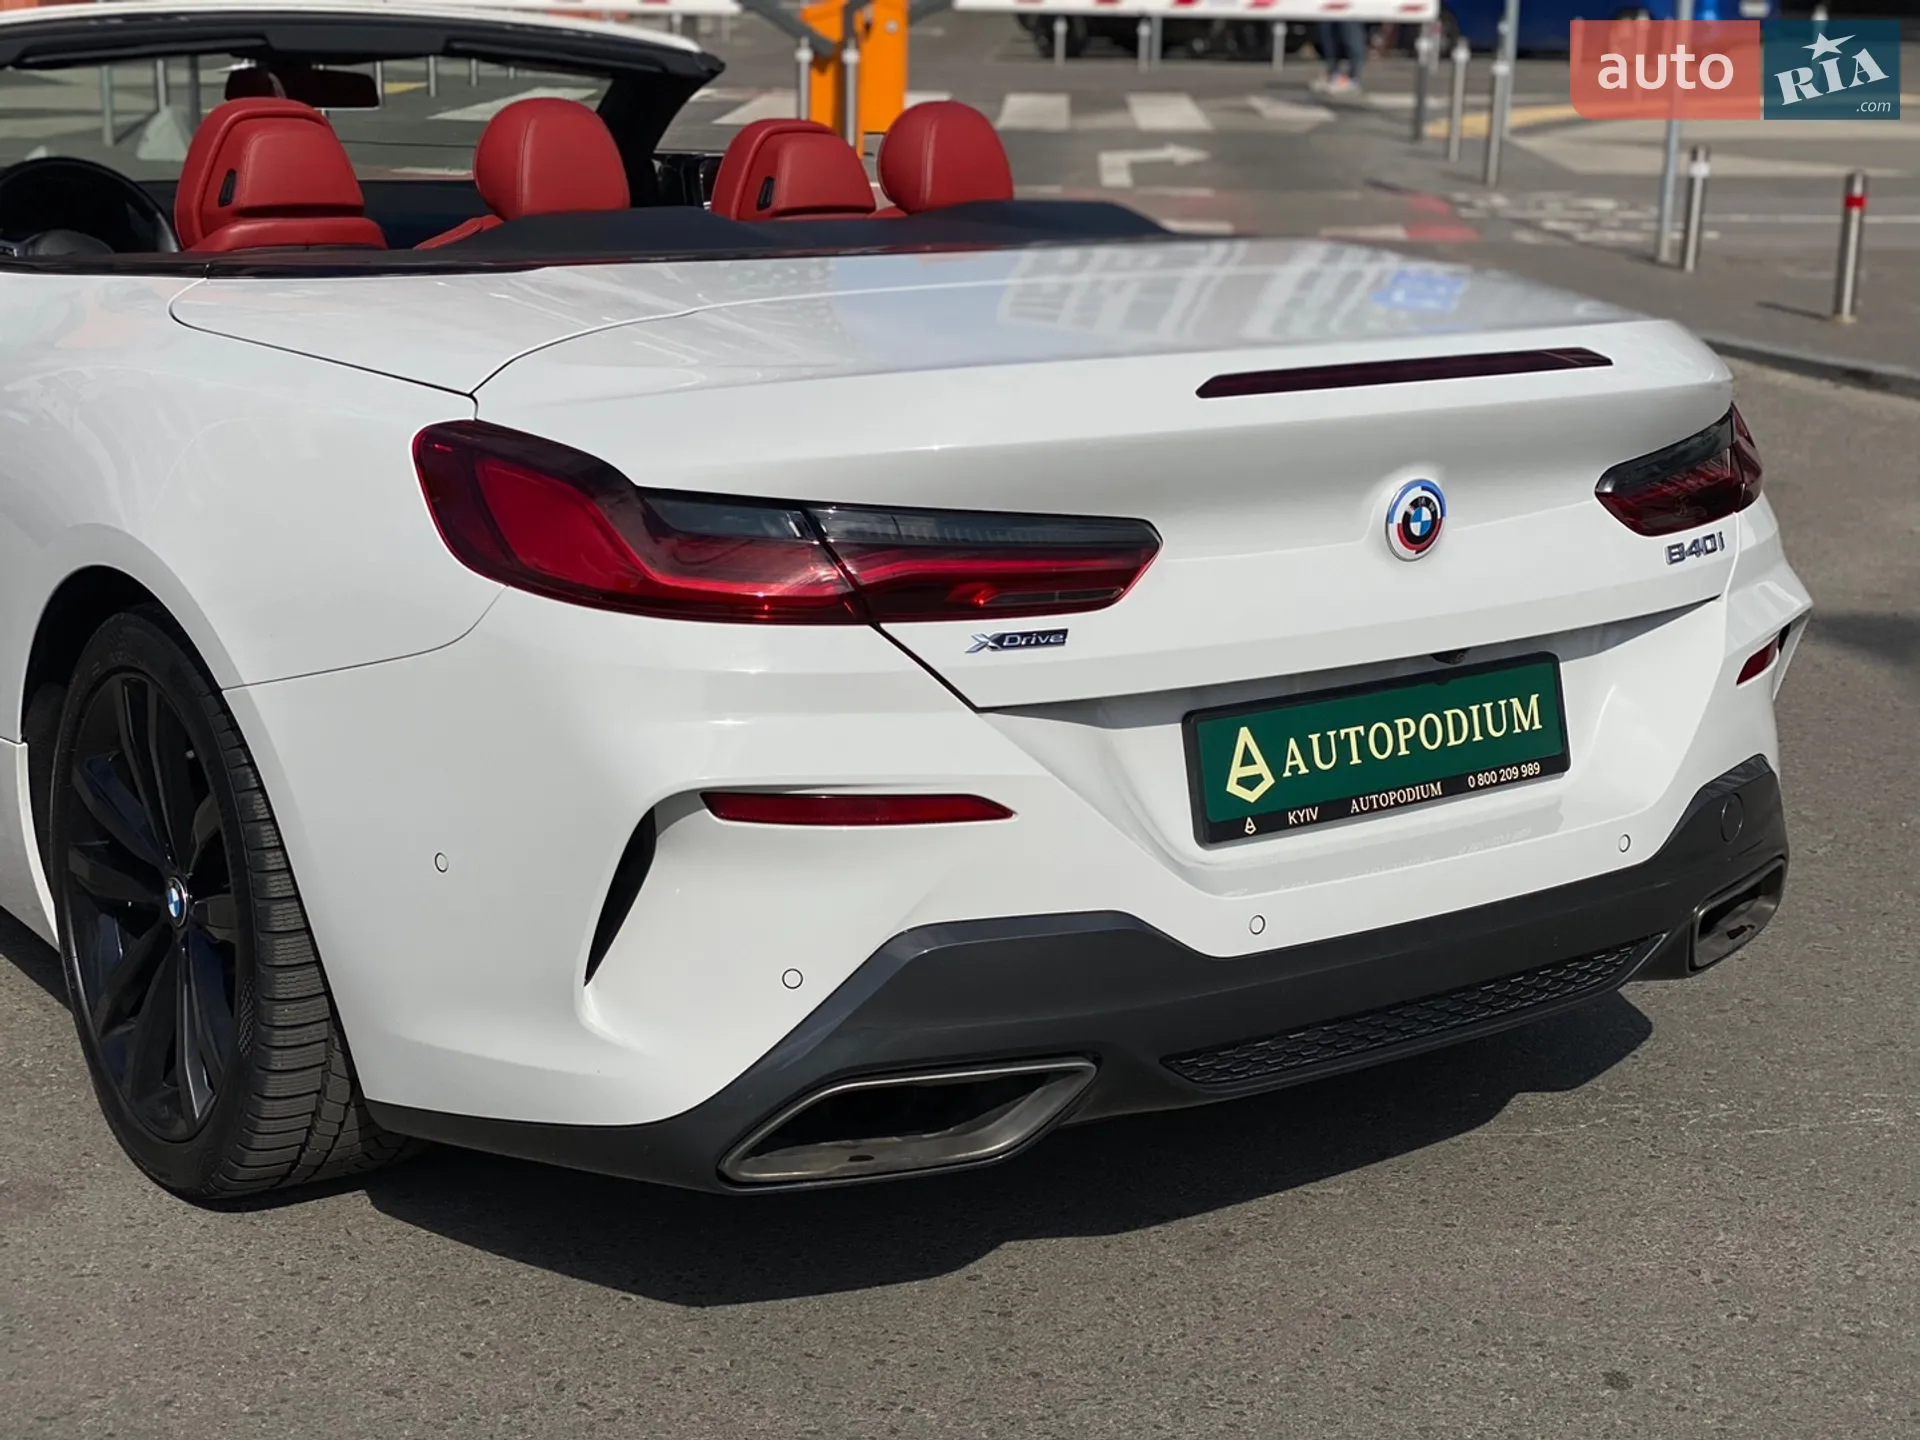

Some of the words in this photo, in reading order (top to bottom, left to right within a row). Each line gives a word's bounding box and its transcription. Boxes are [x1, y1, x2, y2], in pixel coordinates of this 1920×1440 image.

[1282, 694, 1542, 777] AUTOPODIUM
[1288, 807, 1319, 825] KYIV
[1350, 782, 1442, 814] AUTOPODIUM
[1467, 775, 1476, 788] 0
[1477, 770, 1498, 786] 800
[1499, 766, 1519, 782] 209
[1520, 762, 1540, 777] 989
